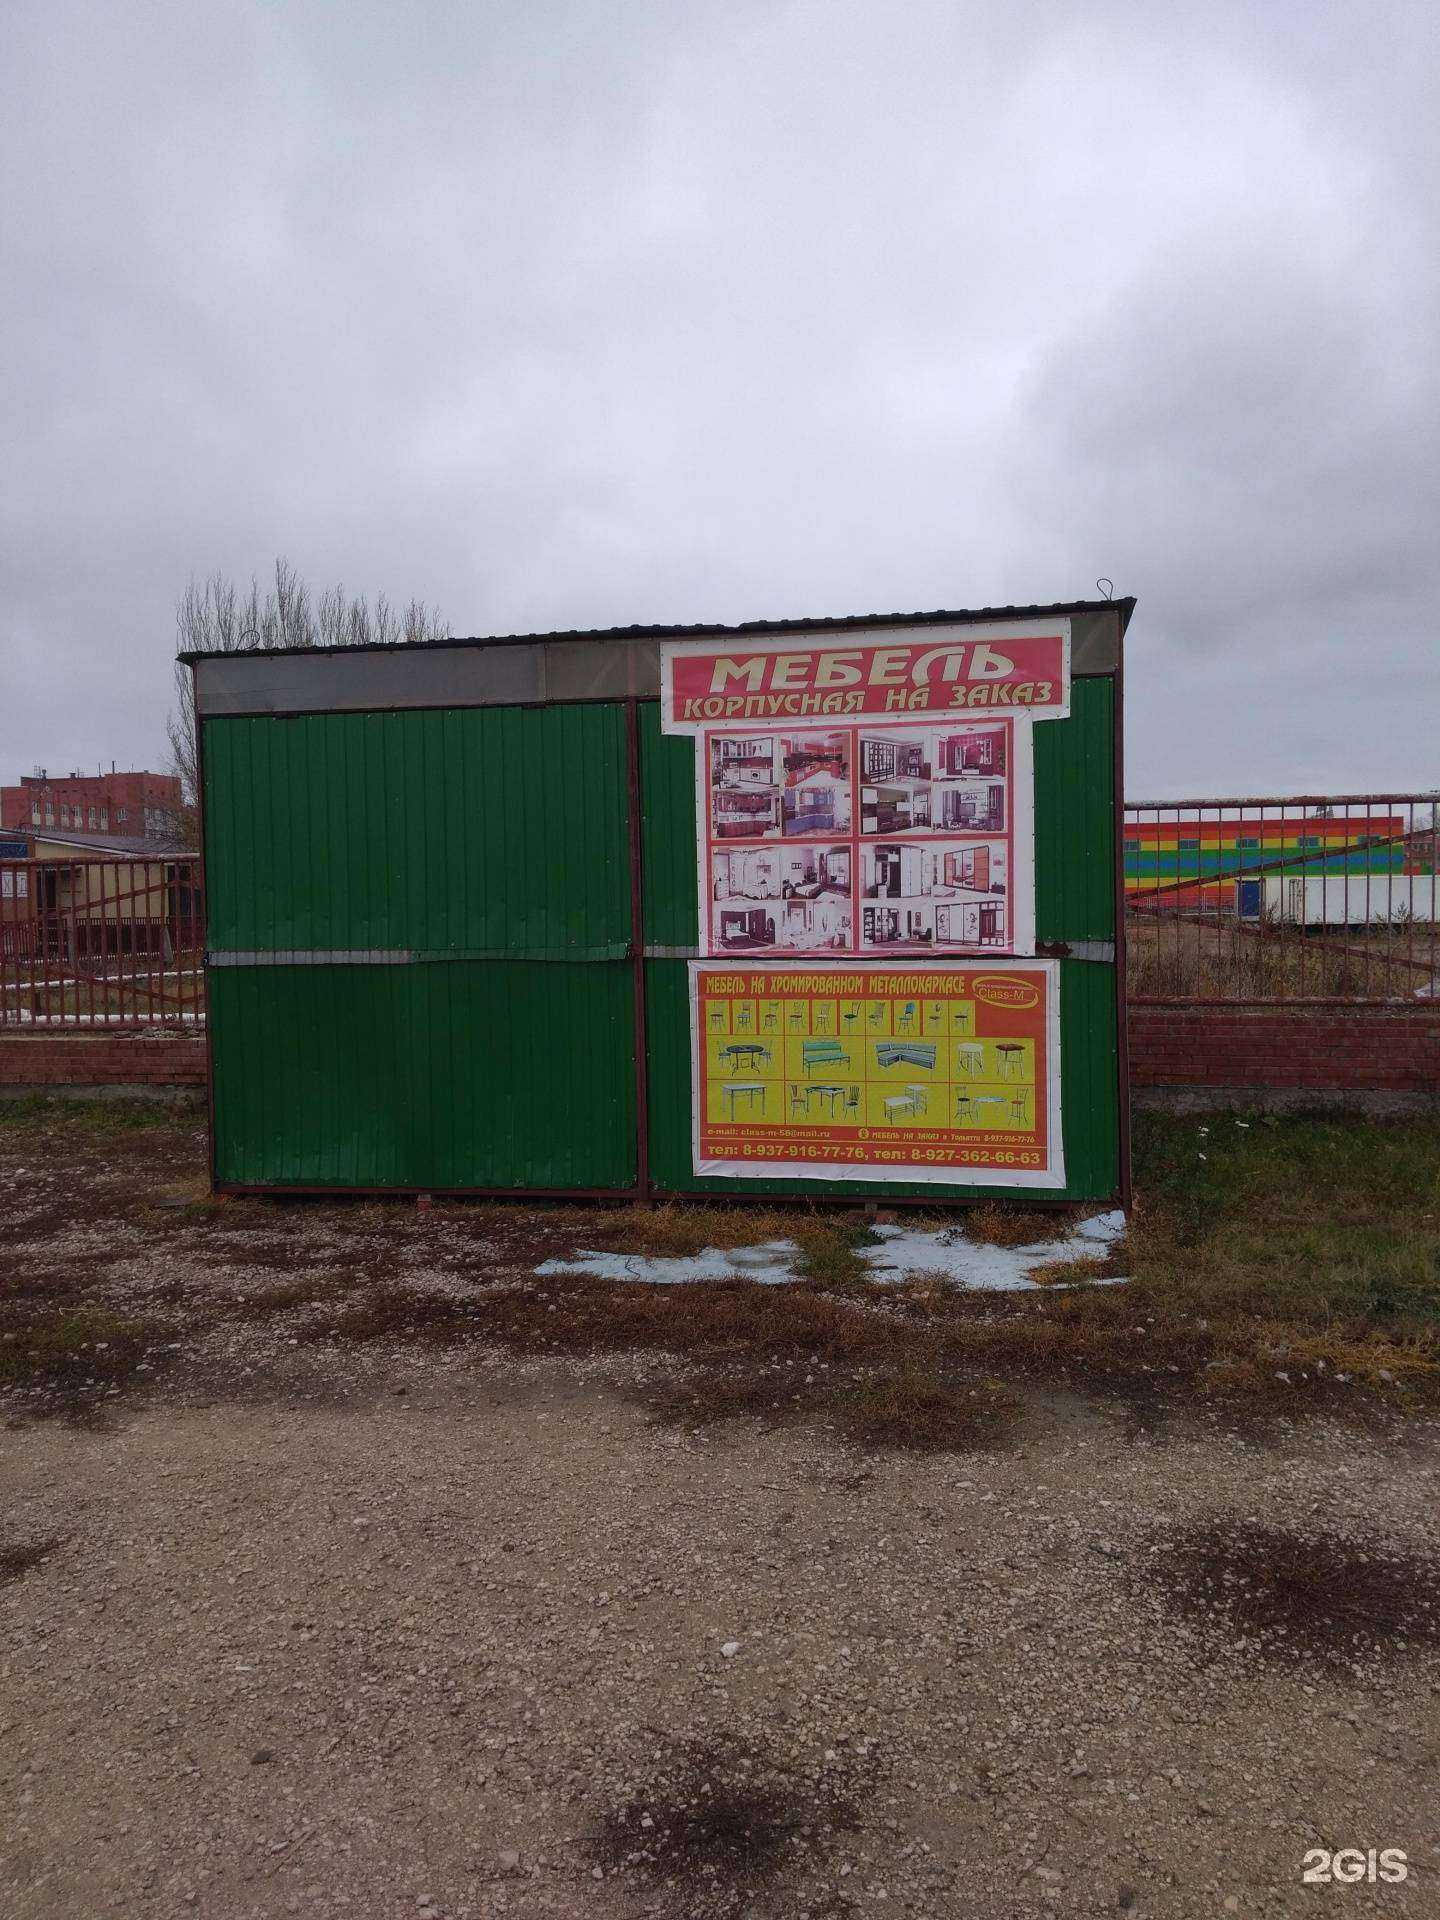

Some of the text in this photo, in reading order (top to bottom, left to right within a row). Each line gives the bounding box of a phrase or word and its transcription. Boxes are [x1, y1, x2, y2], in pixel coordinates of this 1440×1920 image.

[709, 644, 1016, 694] МЕБЕЛЬ
[683, 681, 1053, 719] КОРПУСНАЯ НА ЗАКАЗ
[706, 976, 746, 993] МЕБЕЛЬ
[751, 976, 765, 994] НА
[708, 1144, 1040, 1165] тел: 8-937-916-77-76, тел: 8-927-362-66-63
